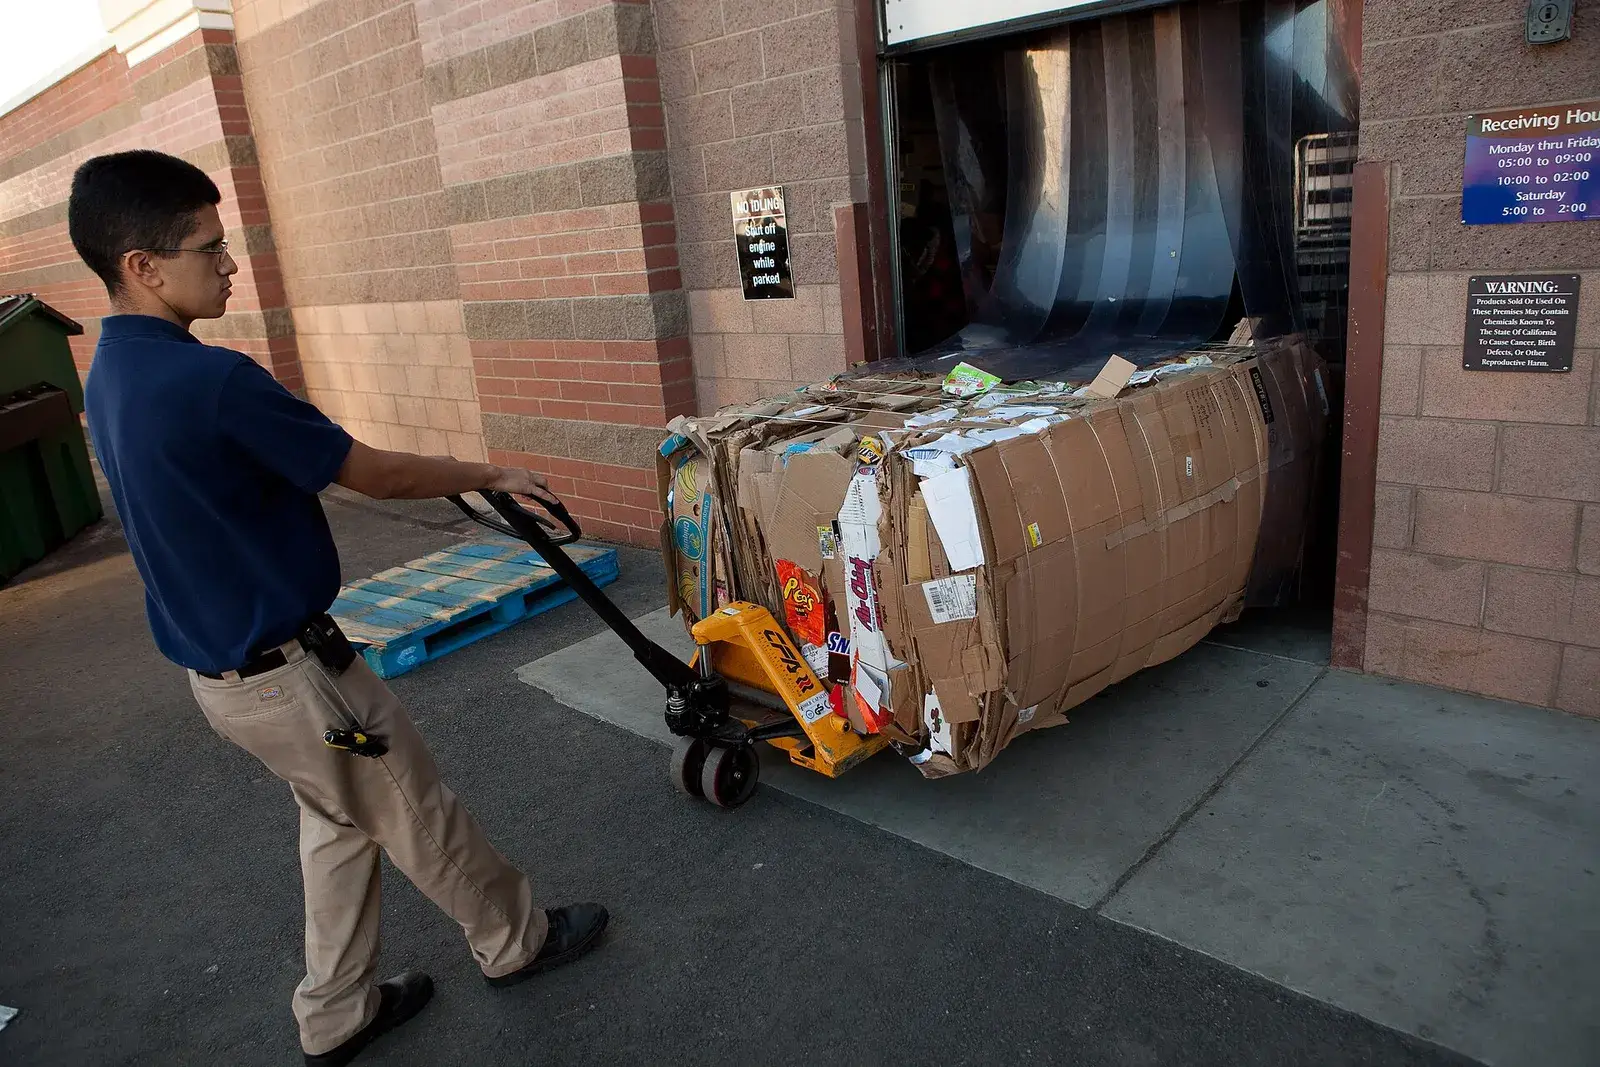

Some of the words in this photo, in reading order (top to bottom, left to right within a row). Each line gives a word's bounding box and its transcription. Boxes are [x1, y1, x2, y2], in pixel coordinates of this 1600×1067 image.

[1481, 113, 1560, 132] Receiving
[1489, 143, 1534, 155] Monday
[1538, 140, 1563, 151] thru
[1498, 157, 1532, 168] 05:00
[1537, 157, 1549, 167] to
[1555, 152, 1592, 164] 09:00
[1497, 175, 1530, 186] 10:00
[1535, 175, 1548, 184] to
[1553, 171, 1590, 182] 02:00
[1516, 189, 1566, 202] Saturday
[736, 201, 749, 214] NO
[751, 198, 779, 213] IDLING
[1502, 206, 1528, 216] 5:00
[1532, 206, 1545, 216] to
[1558, 203, 1587, 214] 2:00
[744, 224, 763, 237] Shut
[764, 223, 776, 235] off
[748, 240, 776, 254] engine
[752, 256, 775, 269] while
[752, 272, 781, 287] parked
[1485, 280, 1559, 293] WARNING:
[1524, 308, 1539, 316] May
[1486, 348, 1513, 356] Defects,
[1481, 358, 1526, 366] Reproductive
